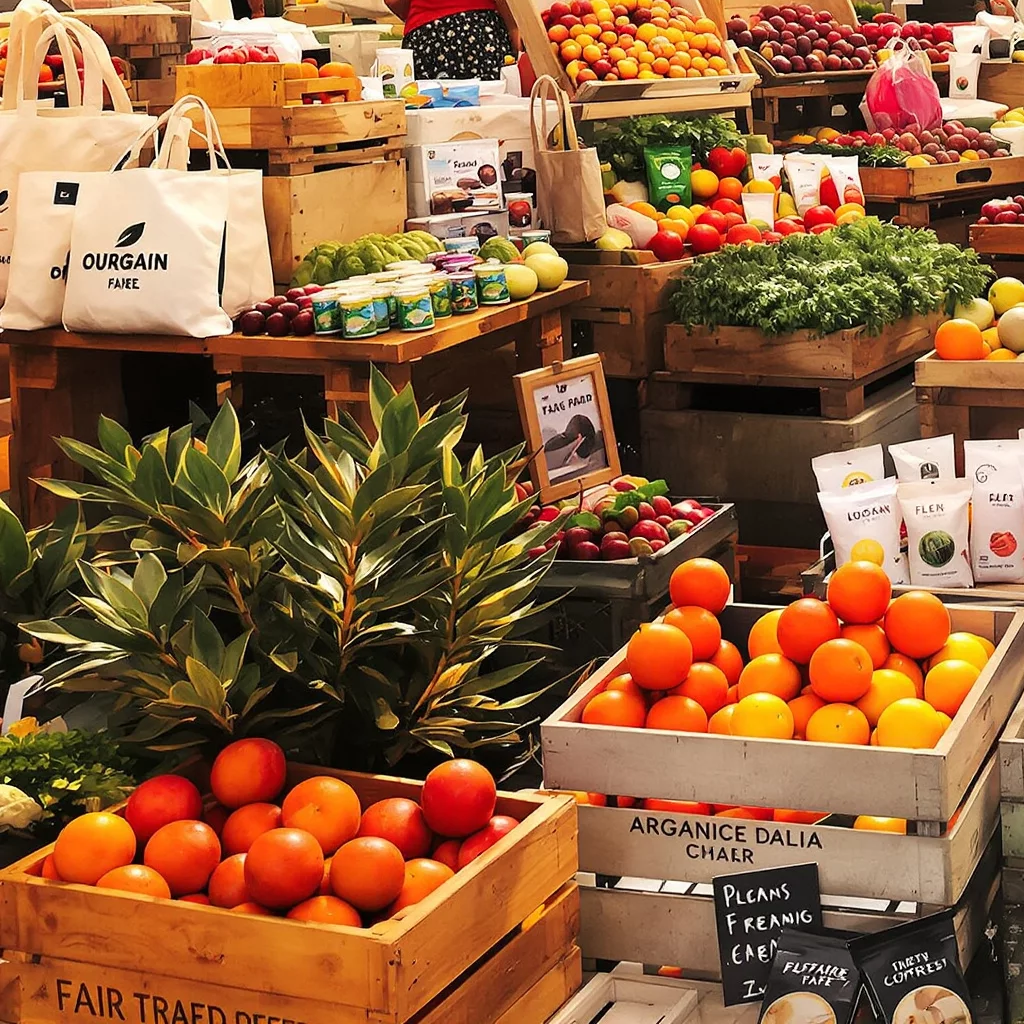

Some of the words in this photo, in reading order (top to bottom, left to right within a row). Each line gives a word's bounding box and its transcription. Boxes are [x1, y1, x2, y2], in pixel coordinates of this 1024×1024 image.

[82, 253, 168, 271] OURGAIN
[629, 816, 747, 843] ARGANICE
[755, 827, 823, 850] DALIA
[56, 979, 125, 1020] FAIR
